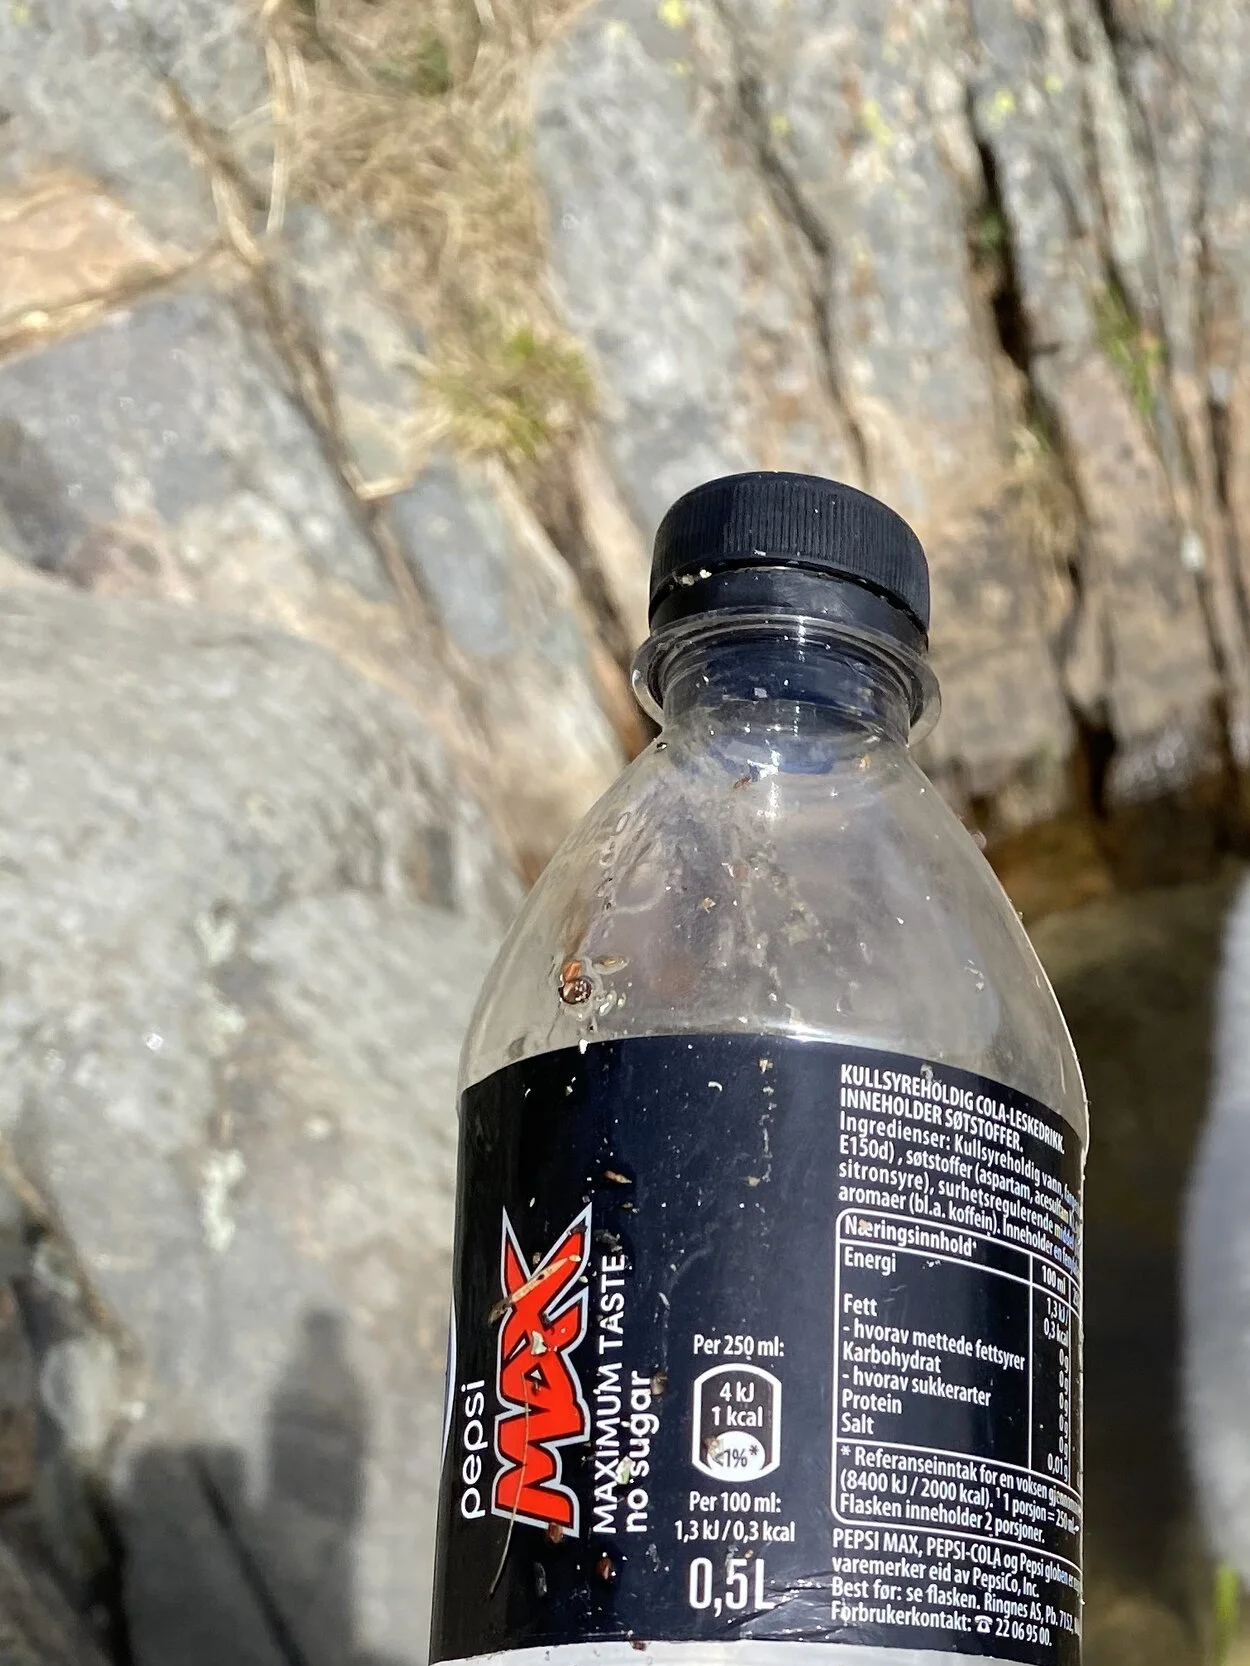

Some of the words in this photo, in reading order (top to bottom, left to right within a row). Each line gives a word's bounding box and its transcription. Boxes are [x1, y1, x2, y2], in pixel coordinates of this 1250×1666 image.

[840, 1063, 974, 1111] KULLSYREHOLDIG
[840, 1087, 943, 1125] INNEHOLDER
[945, 1108, 1024, 1153] SØTSTOFFER.
[839, 1134, 895, 1164] E150d)
[906, 1149, 973, 1180] søtstoffer
[974, 1162, 1033, 1205] (aspartam,
[840, 1110, 951, 1150] Ingredienser:
[954, 1133, 1041, 1187] Kullsyreholdig
[838, 1158, 934, 1196] sitronsyre),
[938, 1180, 1054, 1235] surhetsregulerende
[838, 1185, 906, 1210] aromaer
[908, 1192, 946, 1218] (bl.a.
[948, 1200, 1001, 1236] koffein).
[1002, 1216, 1053, 1256] Inneholder
[844, 1246, 896, 1276] Energi
[1041, 1265, 1057, 1288] 100
[599, 1255, 626, 1355] TASTE
[843, 1293, 878, 1317] Fett
[693, 1334, 721, 1355] Per
[723, 1335, 755, 1356] 250
[757, 1336, 785, 1357] ml:
[843, 1341, 942, 1373] Karbohydrat
[853, 1317, 909, 1345] hvorav
[912, 1330, 973, 1357] mettede
[975, 1339, 1026, 1371] fettsyrer
[491, 1202, 592, 1538] MAX
[719, 1382, 732, 1402] 4
[736, 1381, 755, 1403] kJ
[853, 1365, 909, 1392] hvorav
[911, 1375, 992, 1407] sukkerarter
[629, 1371, 660, 1477] sugar
[711, 1406, 721, 1426] 1
[726, 1405, 764, 1427] kcal
[841, 1412, 875, 1435] Salt
[842, 1389, 903, 1415] Protein
[460, 1379, 489, 1519] pepsi
[593, 1362, 624, 1534] MAXIMUM
[840, 1468, 889, 1493] (8400
[891, 1473, 908, 1495] kJ
[920, 1478, 957, 1501] 2000
[959, 1482, 994, 1510] kcal).
[1012, 1499, 1047, 1523] porsjon
[854, 1446, 978, 1482] Referanseinntak
[979, 1464, 998, 1486] for
[999, 1473, 1014, 1490] en
[1016, 1475, 1048, 1500] voksen
[626, 1488, 649, 1533] no
[689, 1491, 718, 1512] Per
[720, 1492, 751, 1512] 100
[754, 1491, 782, 1513] ml:
[840, 1493, 902, 1518] Flasken
[905, 1499, 983, 1529] inneholder
[984, 1511, 993, 1532] 2
[994, 1518, 1045, 1544] porsjoner.
[674, 1520, 699, 1543] 1,3
[702, 1519, 720, 1541] kJ
[733, 1520, 759, 1544] 0,3
[762, 1520, 796, 1543] kcal
[832, 1528, 880, 1551] PEPSI
[883, 1531, 923, 1558] MAX,
[926, 1536, 1002, 1568] PEPSI-COLA
[1003, 1553, 1018, 1575] og
[1020, 1552, 1044, 1579] Pepsi
[831, 1557, 927, 1579] varemerker
[928, 1561, 951, 1581] eid
[953, 1568, 971, 1585] av
[972, 1566, 1021, 1597] PepsiCo,
[1022, 1576, 1040, 1598] Inc.
[831, 1575, 870, 1598] Best
[873, 1578, 902, 1600] før:
[905, 1586, 923, 1603] se
[925, 1583, 981, 1610] flasken.
[983, 1592, 1028, 1619] Ringnes
[831, 1600, 972, 1632] Forbrukerkontakt:
[995, 1617, 1010, 1638] 22
[1011, 1620, 1025, 1641] 06
[1026, 1623, 1038, 1643] 95
[1039, 1627, 1053, 1647] 00.
